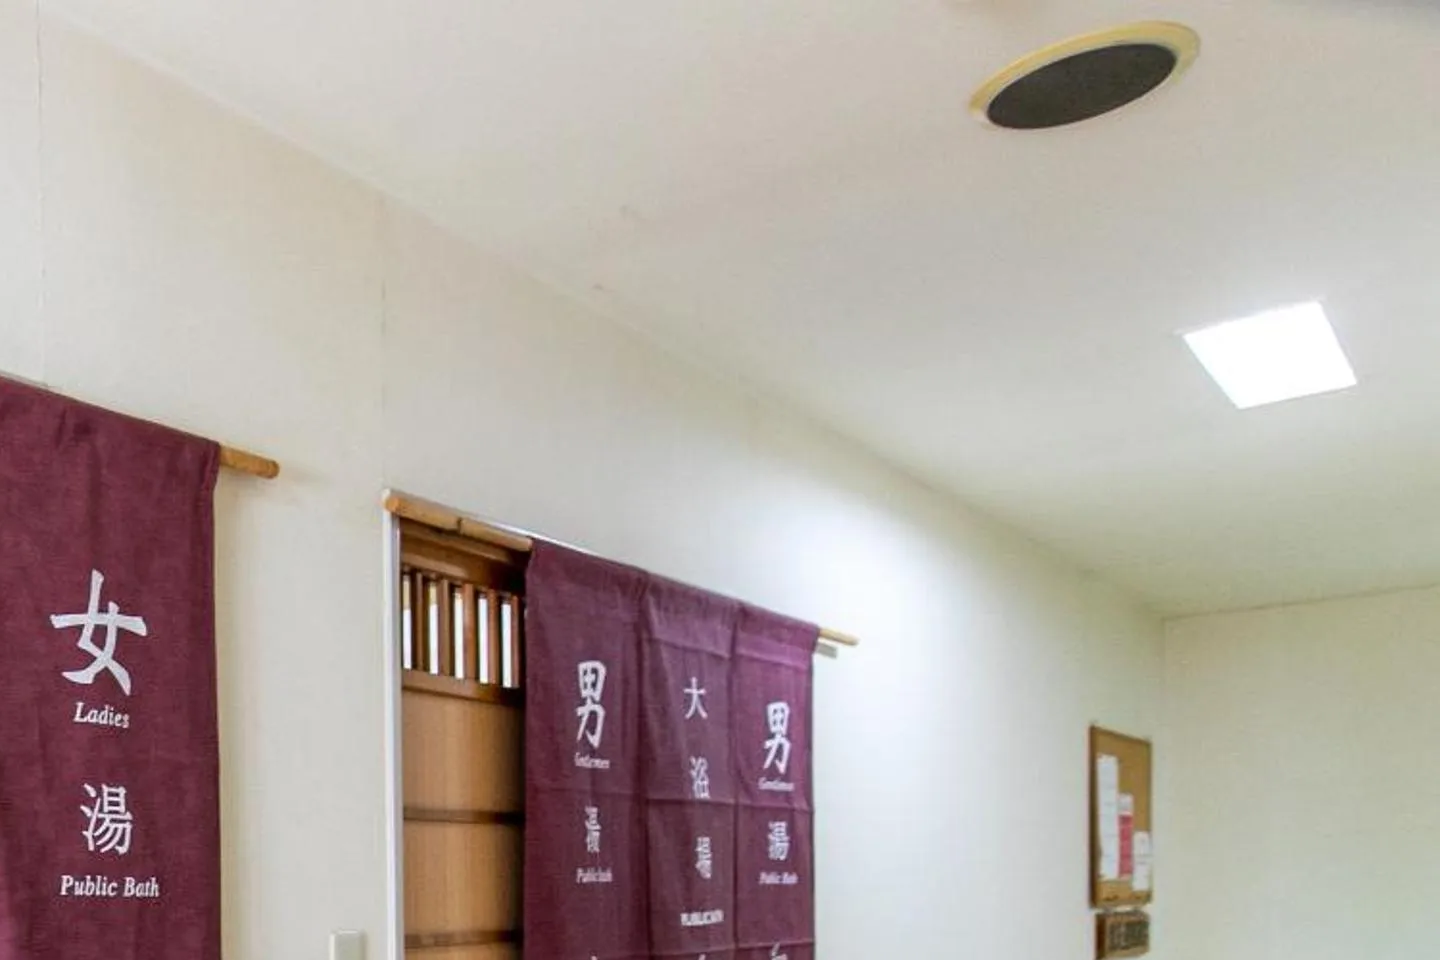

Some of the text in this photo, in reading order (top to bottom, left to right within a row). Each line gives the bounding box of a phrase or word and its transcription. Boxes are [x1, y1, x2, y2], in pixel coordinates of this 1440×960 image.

[50, 569, 148, 696] 女
[74, 702, 130, 728] Ladies
[576, 660, 606, 748] 男
[763, 701, 791, 774] 男
[80, 784, 133, 855] 湯
[60, 874, 160, 898] Public Bath
